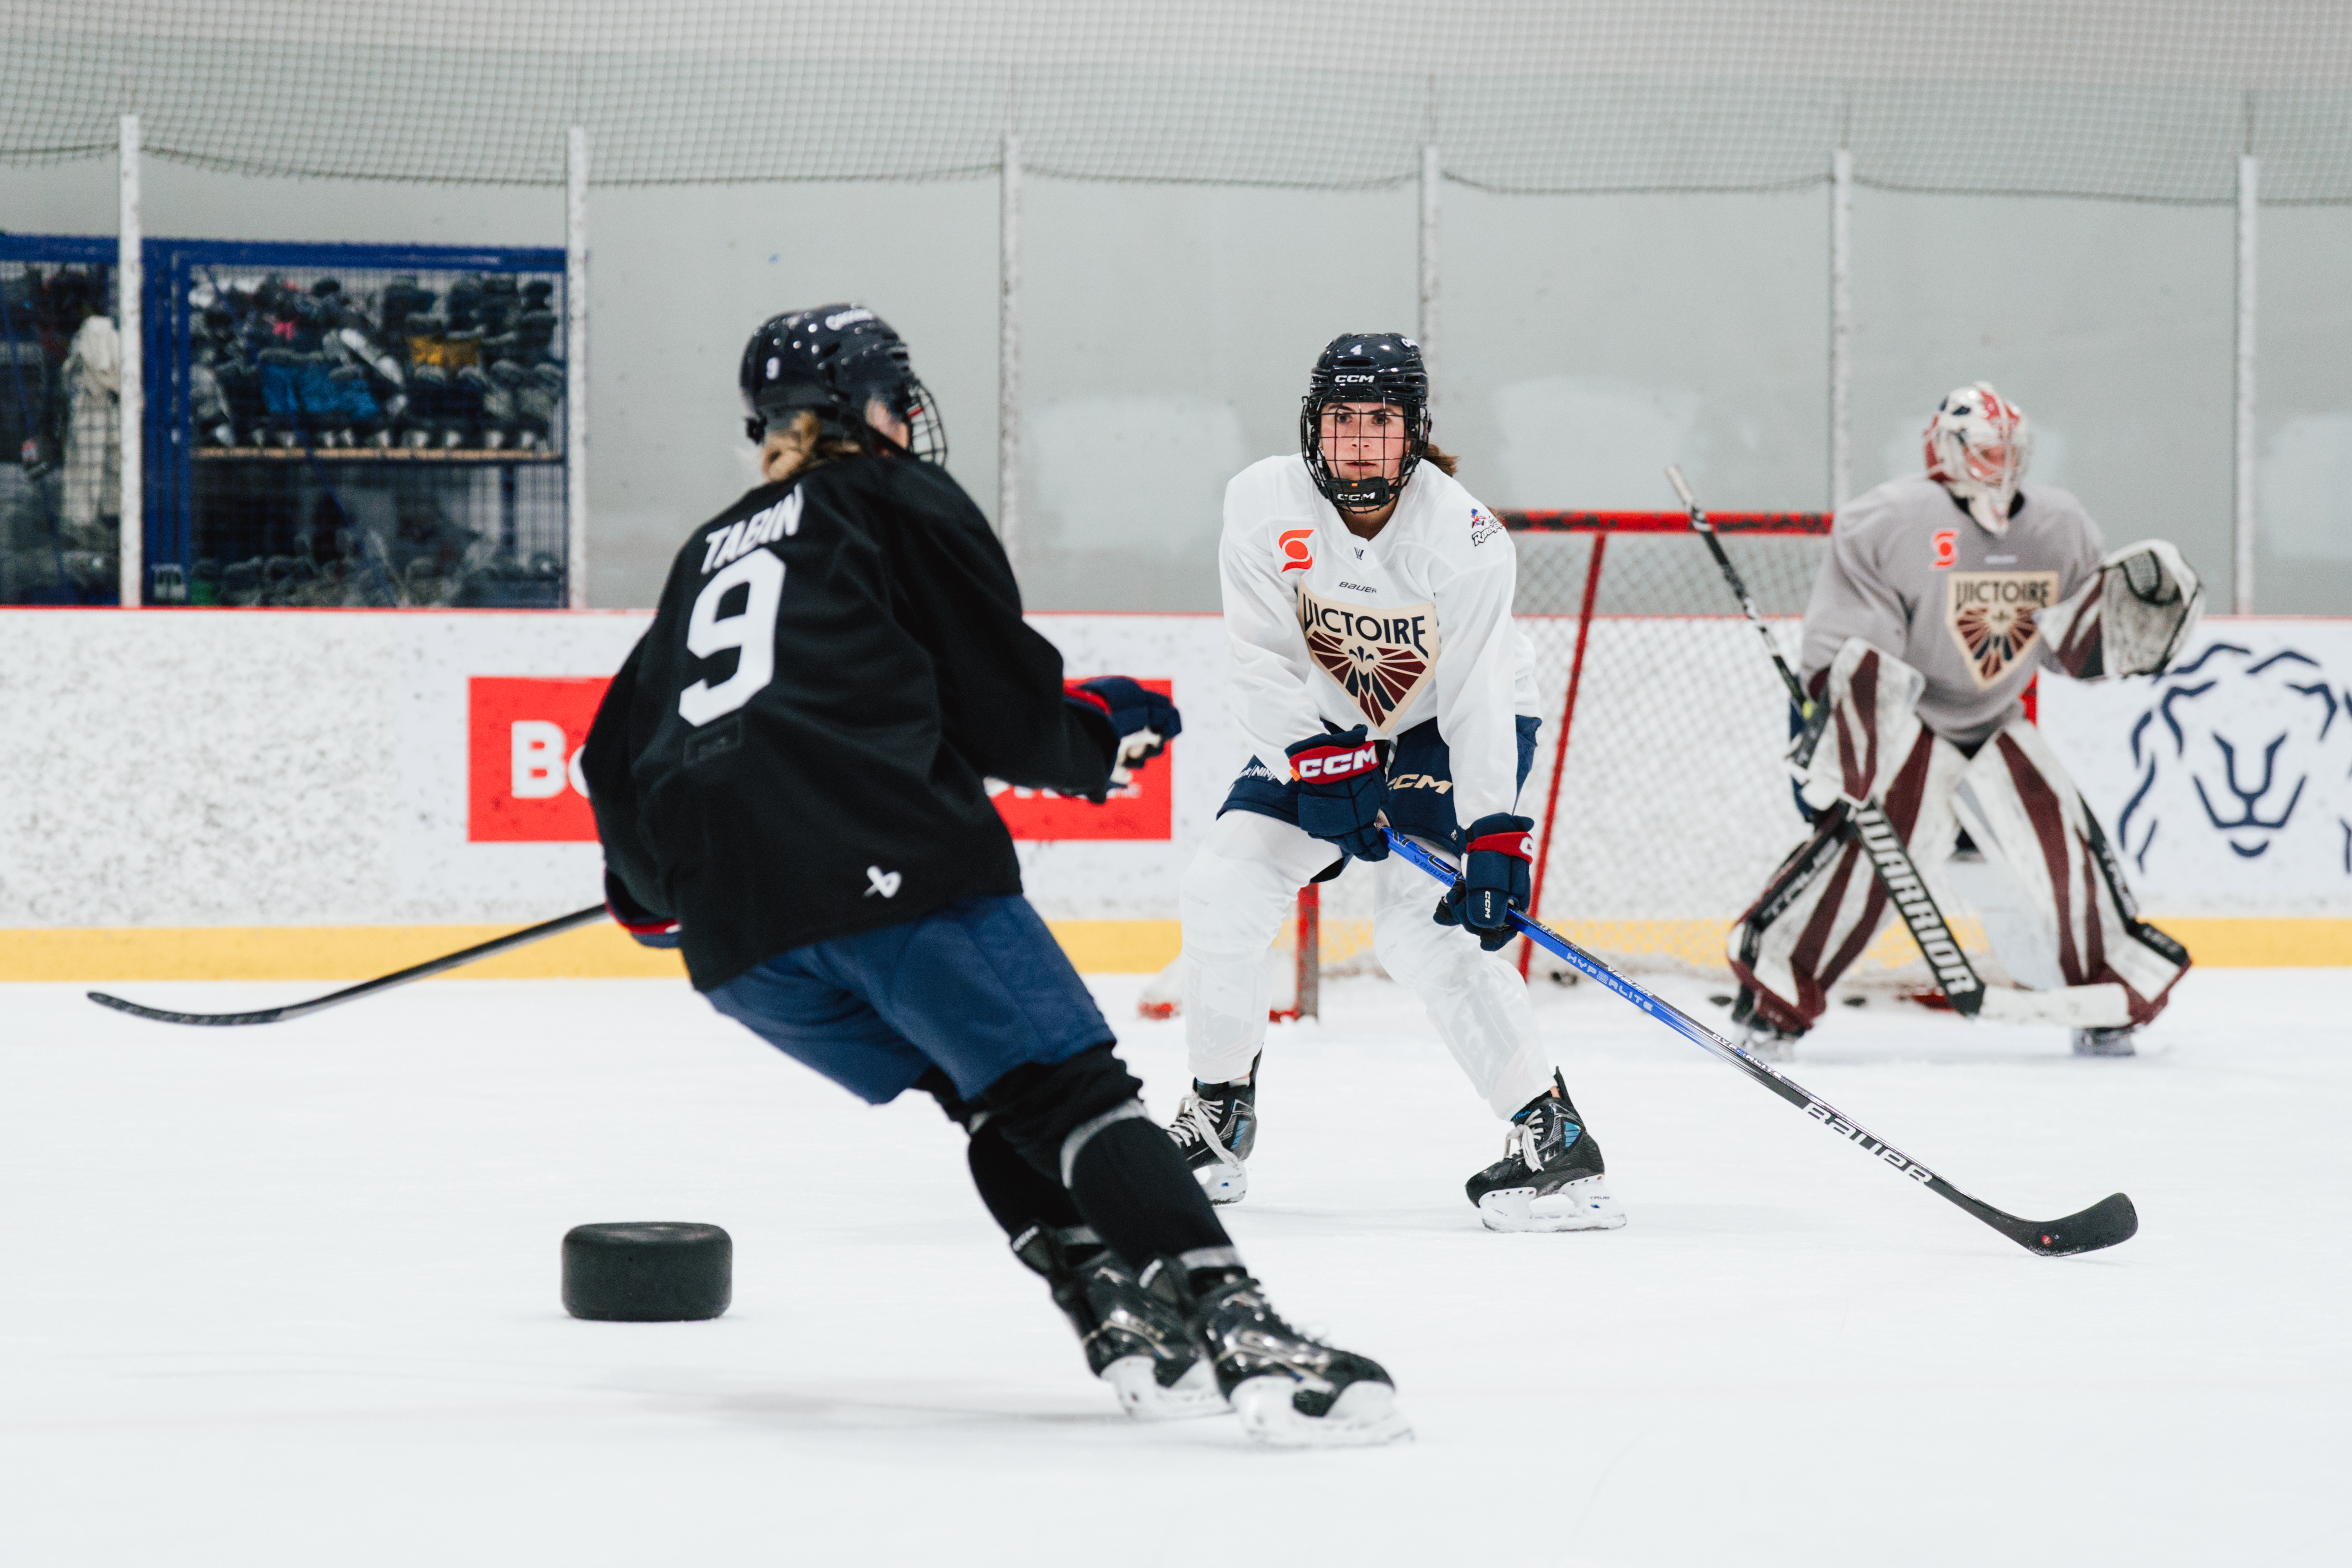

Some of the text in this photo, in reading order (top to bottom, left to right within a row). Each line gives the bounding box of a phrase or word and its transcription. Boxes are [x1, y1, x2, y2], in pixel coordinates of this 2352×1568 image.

[1350, 344, 1362, 355] 4
[1335, 375, 1375, 383] CCM
[1337, 492, 1376, 501] CCM
[700, 483, 804, 574] TABIN
[1956, 581, 2050, 609] VICTOIRE
[678, 548, 786, 727] 9
[1303, 593, 1429, 659] VICTOIRE
[1299, 745, 1377, 778] CCM
[1854, 808, 1978, 996] WARRIOR
